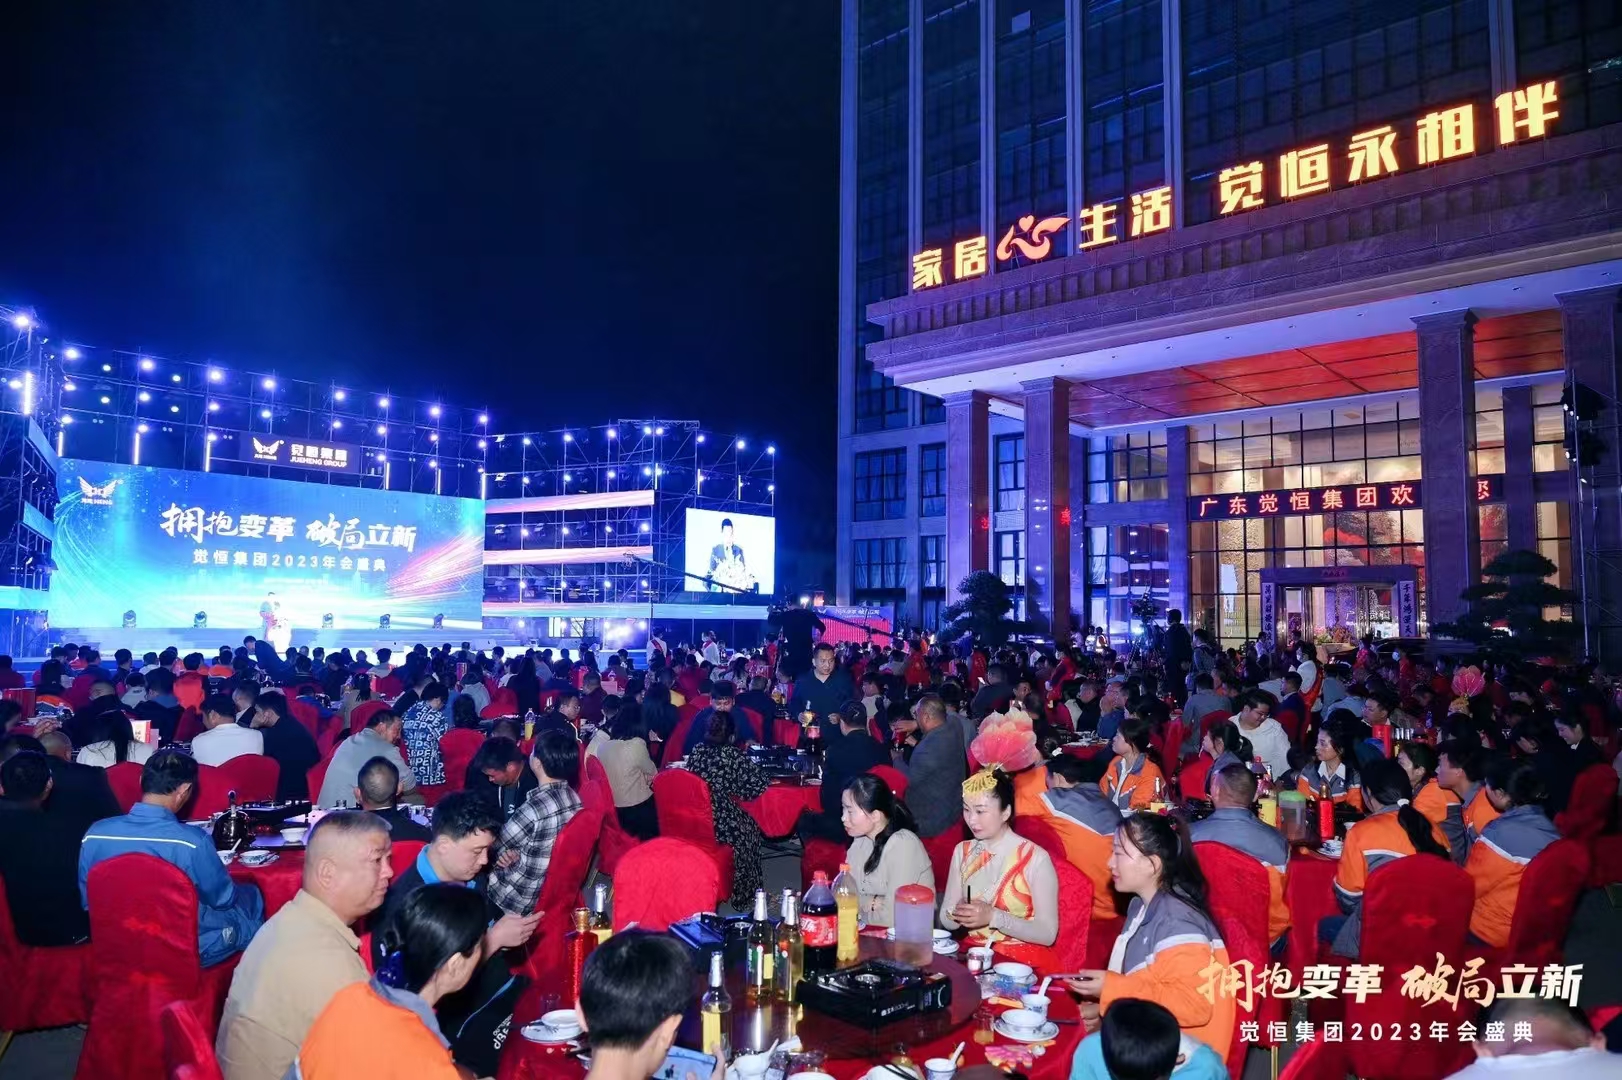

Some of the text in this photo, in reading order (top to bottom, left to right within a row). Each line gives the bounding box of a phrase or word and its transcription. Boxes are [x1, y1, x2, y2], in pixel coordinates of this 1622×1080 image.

[1218, 81, 1560, 214] 觉恒永相伴
[323, 459, 347, 467] GROUP
[160, 502, 417, 552] 拥抱变革 破局立新
[193, 548, 387, 572] 觉恒集团2023年会盛典
